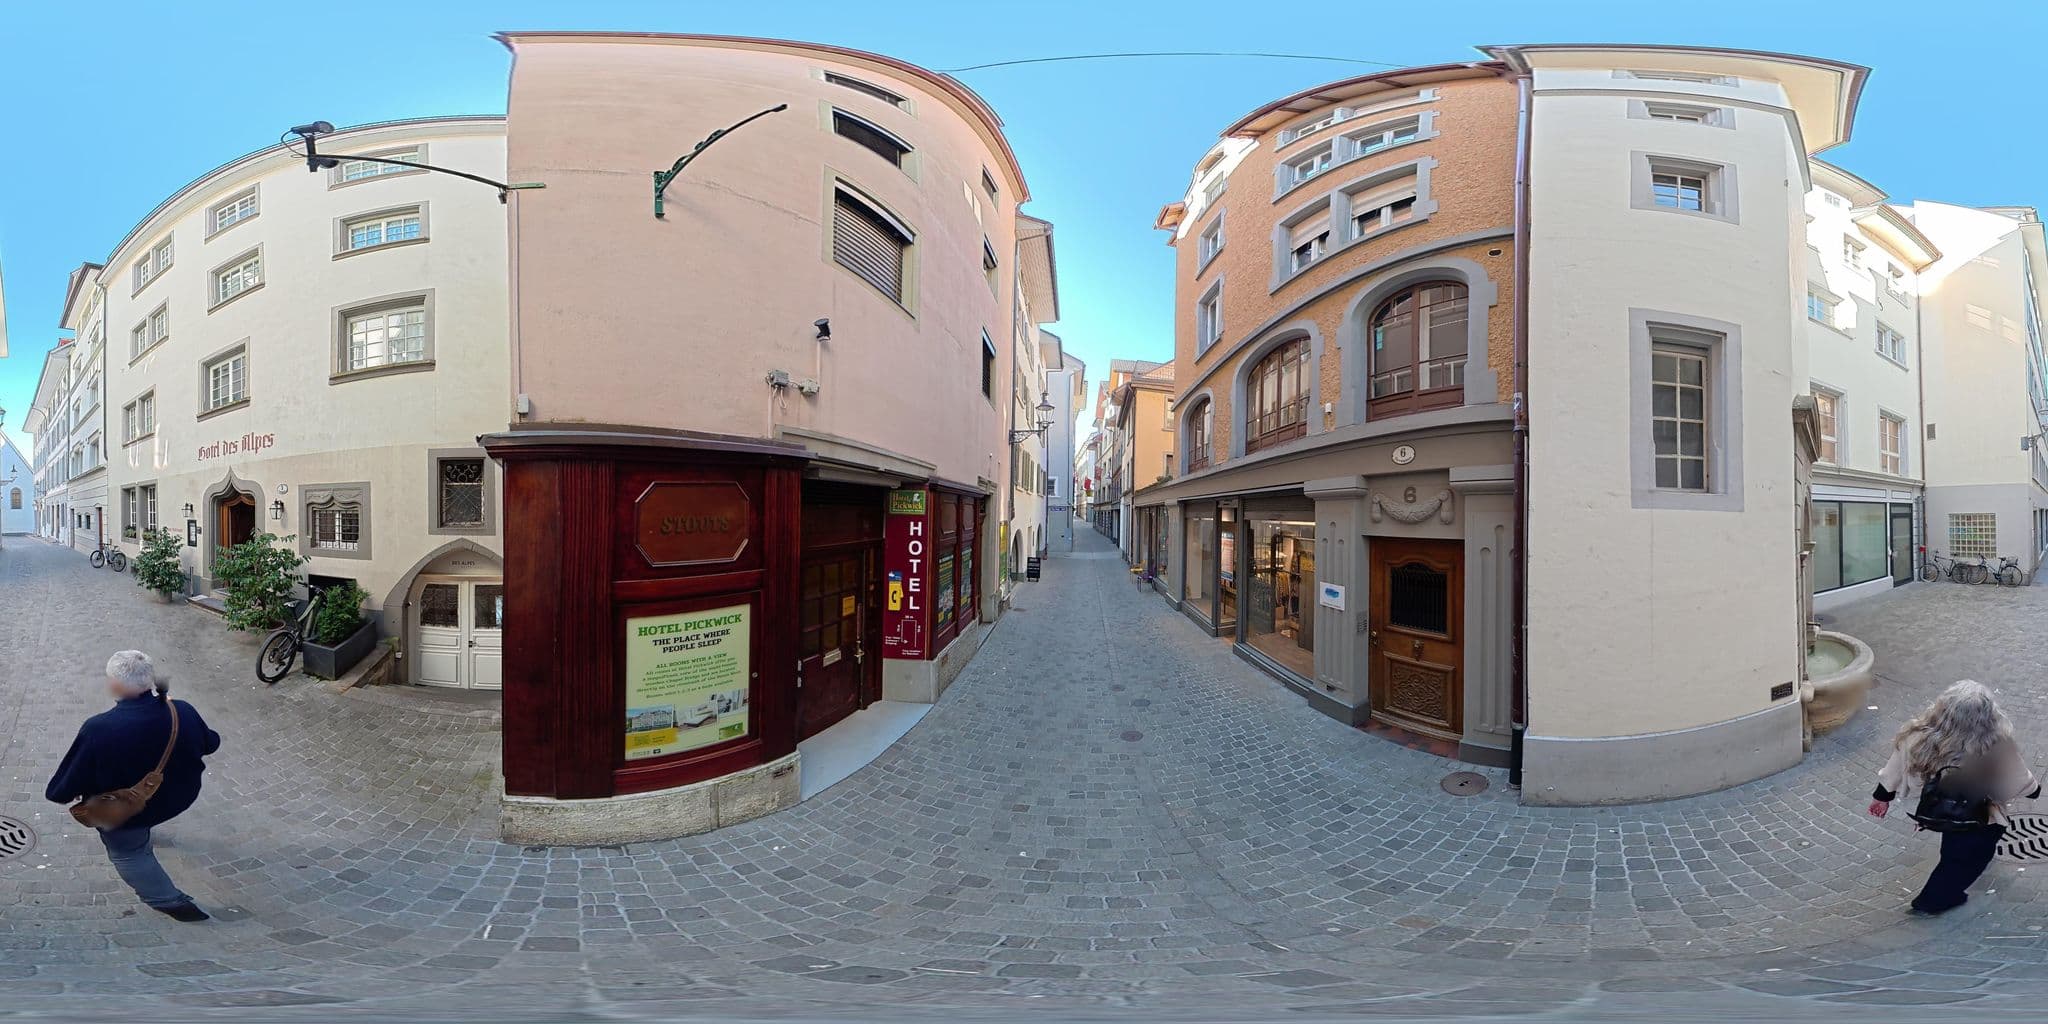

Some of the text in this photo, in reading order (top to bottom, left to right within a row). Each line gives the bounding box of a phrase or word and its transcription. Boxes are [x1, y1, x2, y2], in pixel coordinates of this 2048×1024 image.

[198, 432, 275, 461] Hotel des Alpes
[1401, 447, 1406, 457] 6
[1404, 486, 1416, 504] 6
[908, 521, 923, 610] HOTEL
[638, 614, 742, 637] HOTEL PICKWICK
[673, 633, 700, 644] PLACE
[704, 628, 730, 639] WHERE
[662, 639, 722, 654] PEOPLE SLEEP
